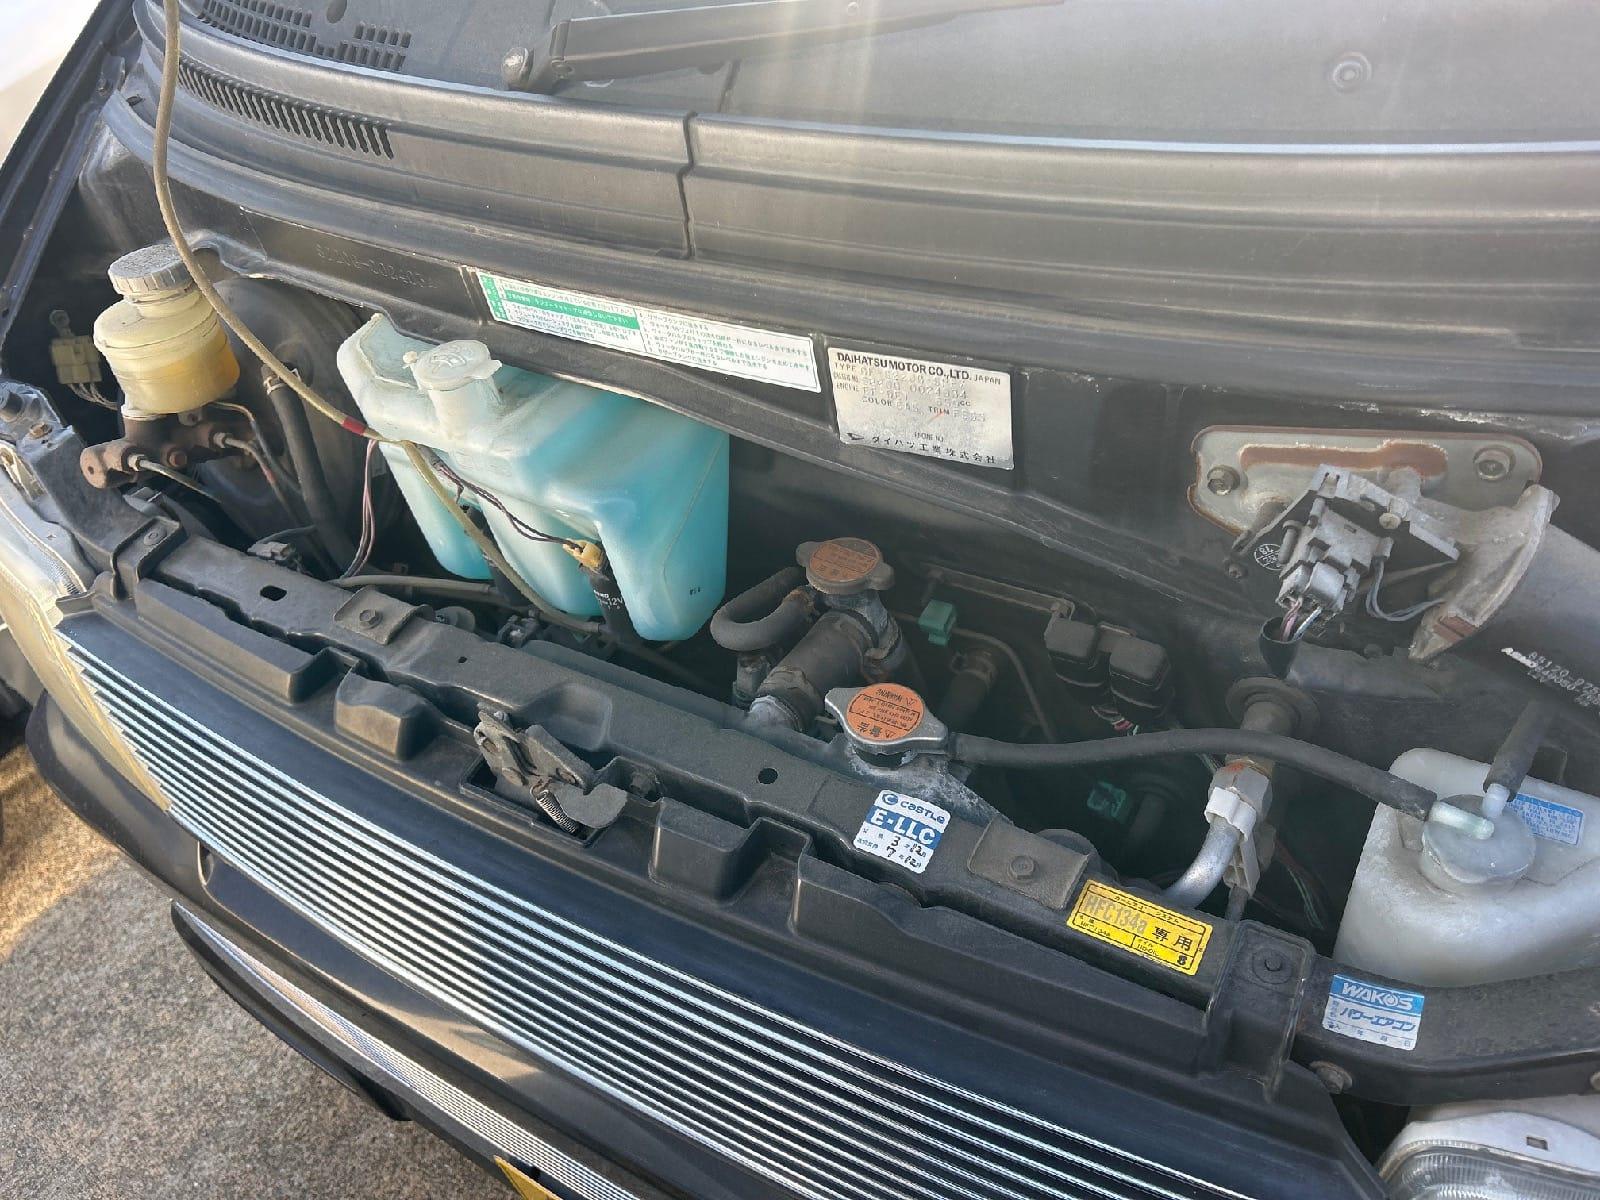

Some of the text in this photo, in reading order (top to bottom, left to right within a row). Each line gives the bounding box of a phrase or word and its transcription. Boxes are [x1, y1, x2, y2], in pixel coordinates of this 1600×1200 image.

[834, 362, 857, 372] TYPE
[837, 352, 888, 368] DAIHATSU
[889, 359, 927, 374] MOTOR
[973, 374, 1001, 385] JAPAN
[928, 405, 950, 415] TRIM
[870, 808, 936, 846] E-LLC
[1151, 925, 1194, 952] 専用
[1339, 1006, 1417, 1032] パワーエアコン
